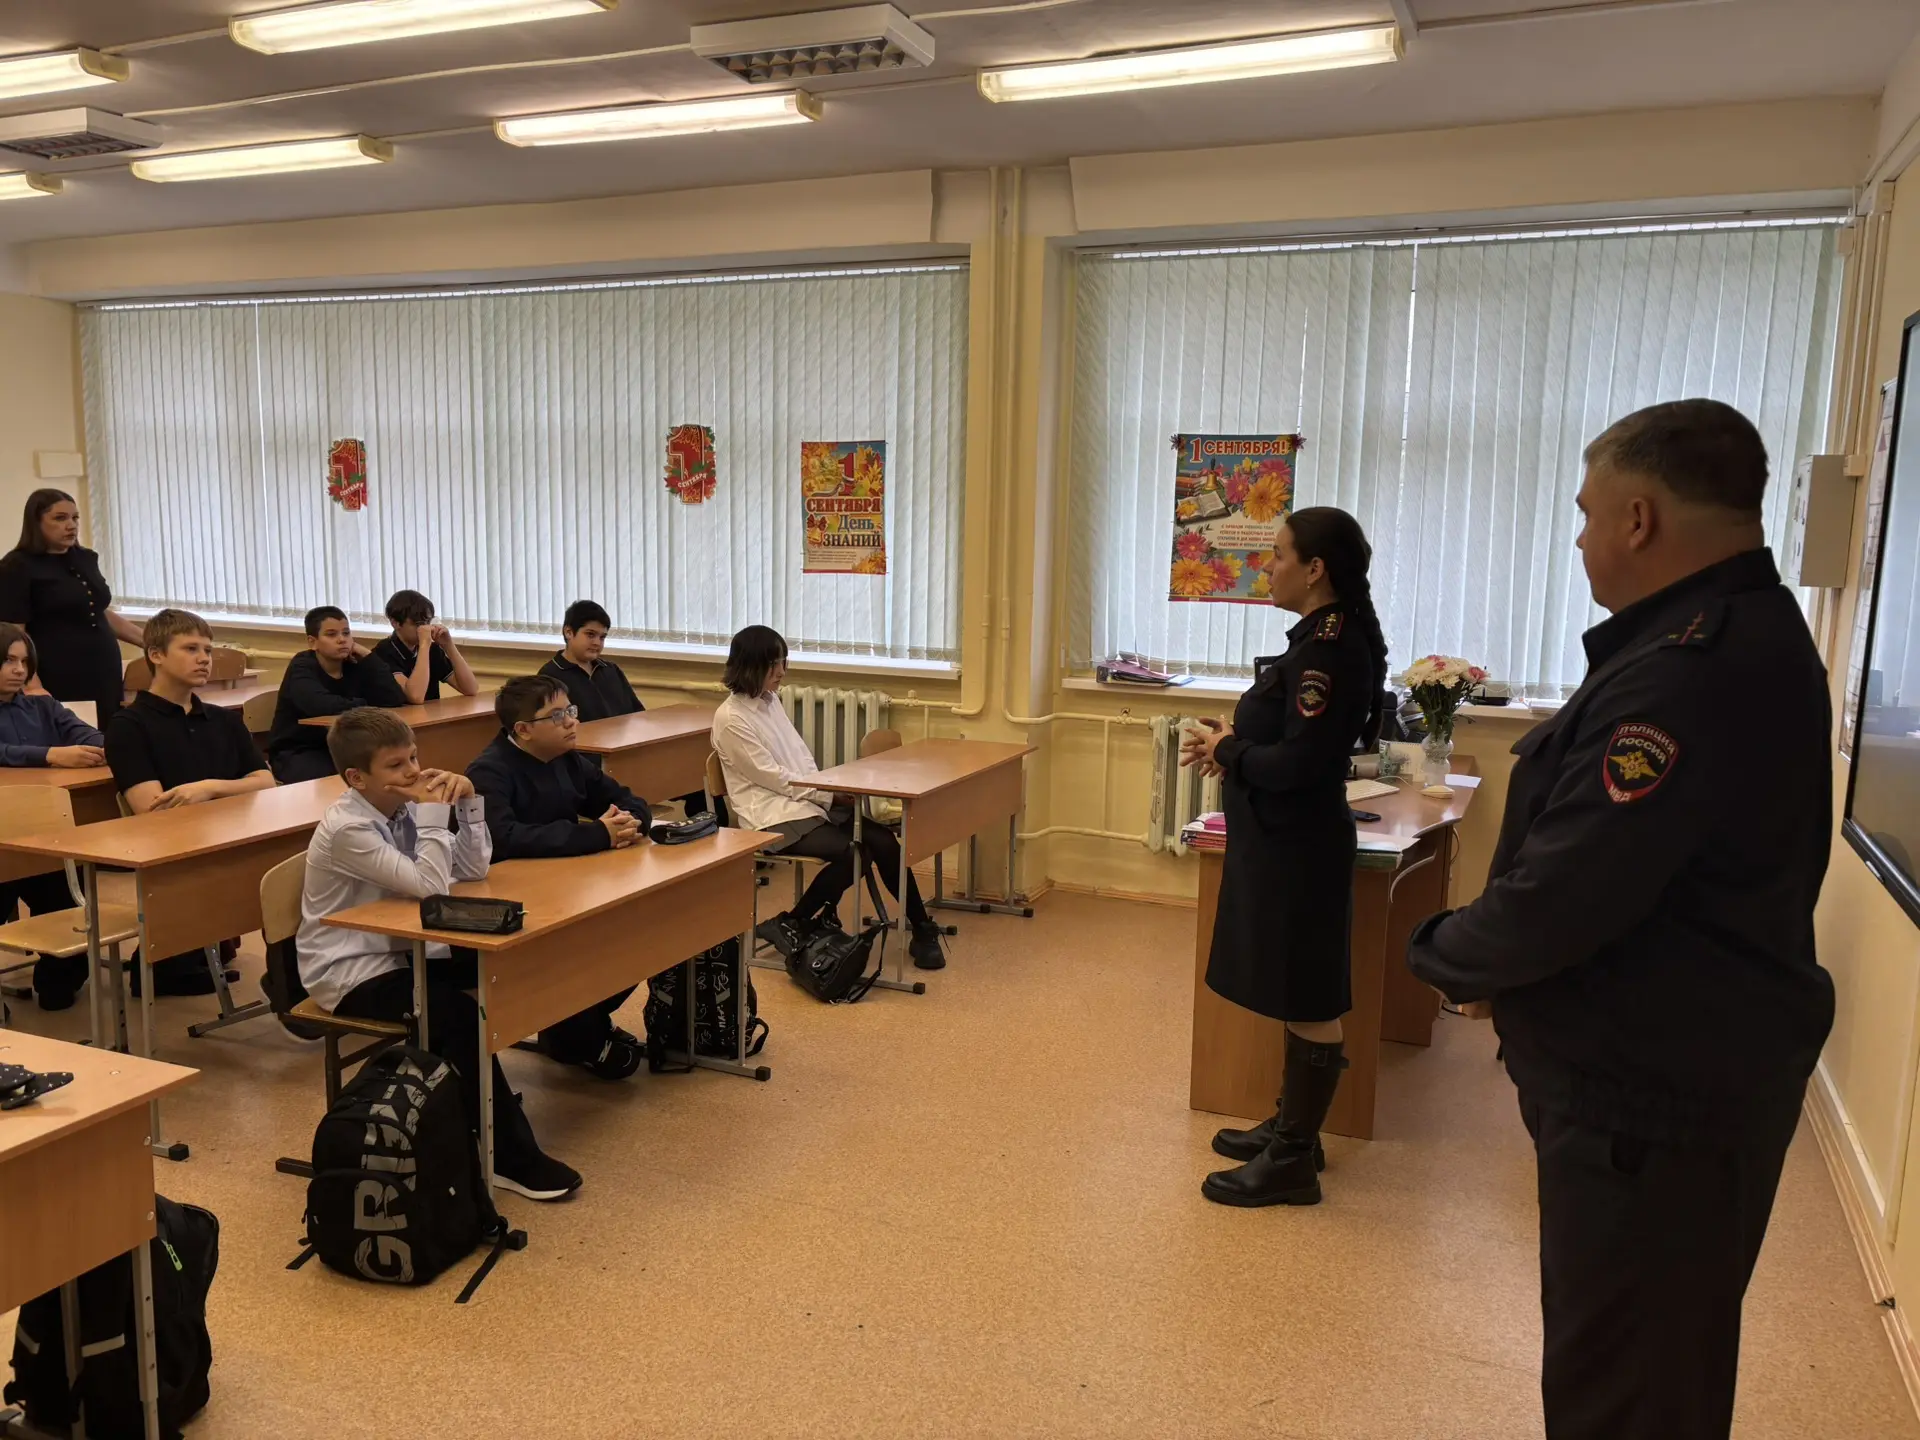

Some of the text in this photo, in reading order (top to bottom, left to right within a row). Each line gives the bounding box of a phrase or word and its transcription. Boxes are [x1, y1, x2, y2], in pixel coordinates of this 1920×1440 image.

[1190, 437, 1289, 463] 1 СЕНТЯБРЯ!
[837, 452, 856, 496] 1
[805, 498, 882, 513] СЕНТЯБРЯ
[838, 514, 875, 533] День
[822, 531, 882, 547] ЗНАНИЙ
[1616, 737, 1668, 764] РОССИЯ
[1618, 725, 1676, 755] ПОЛИЦИЯ
